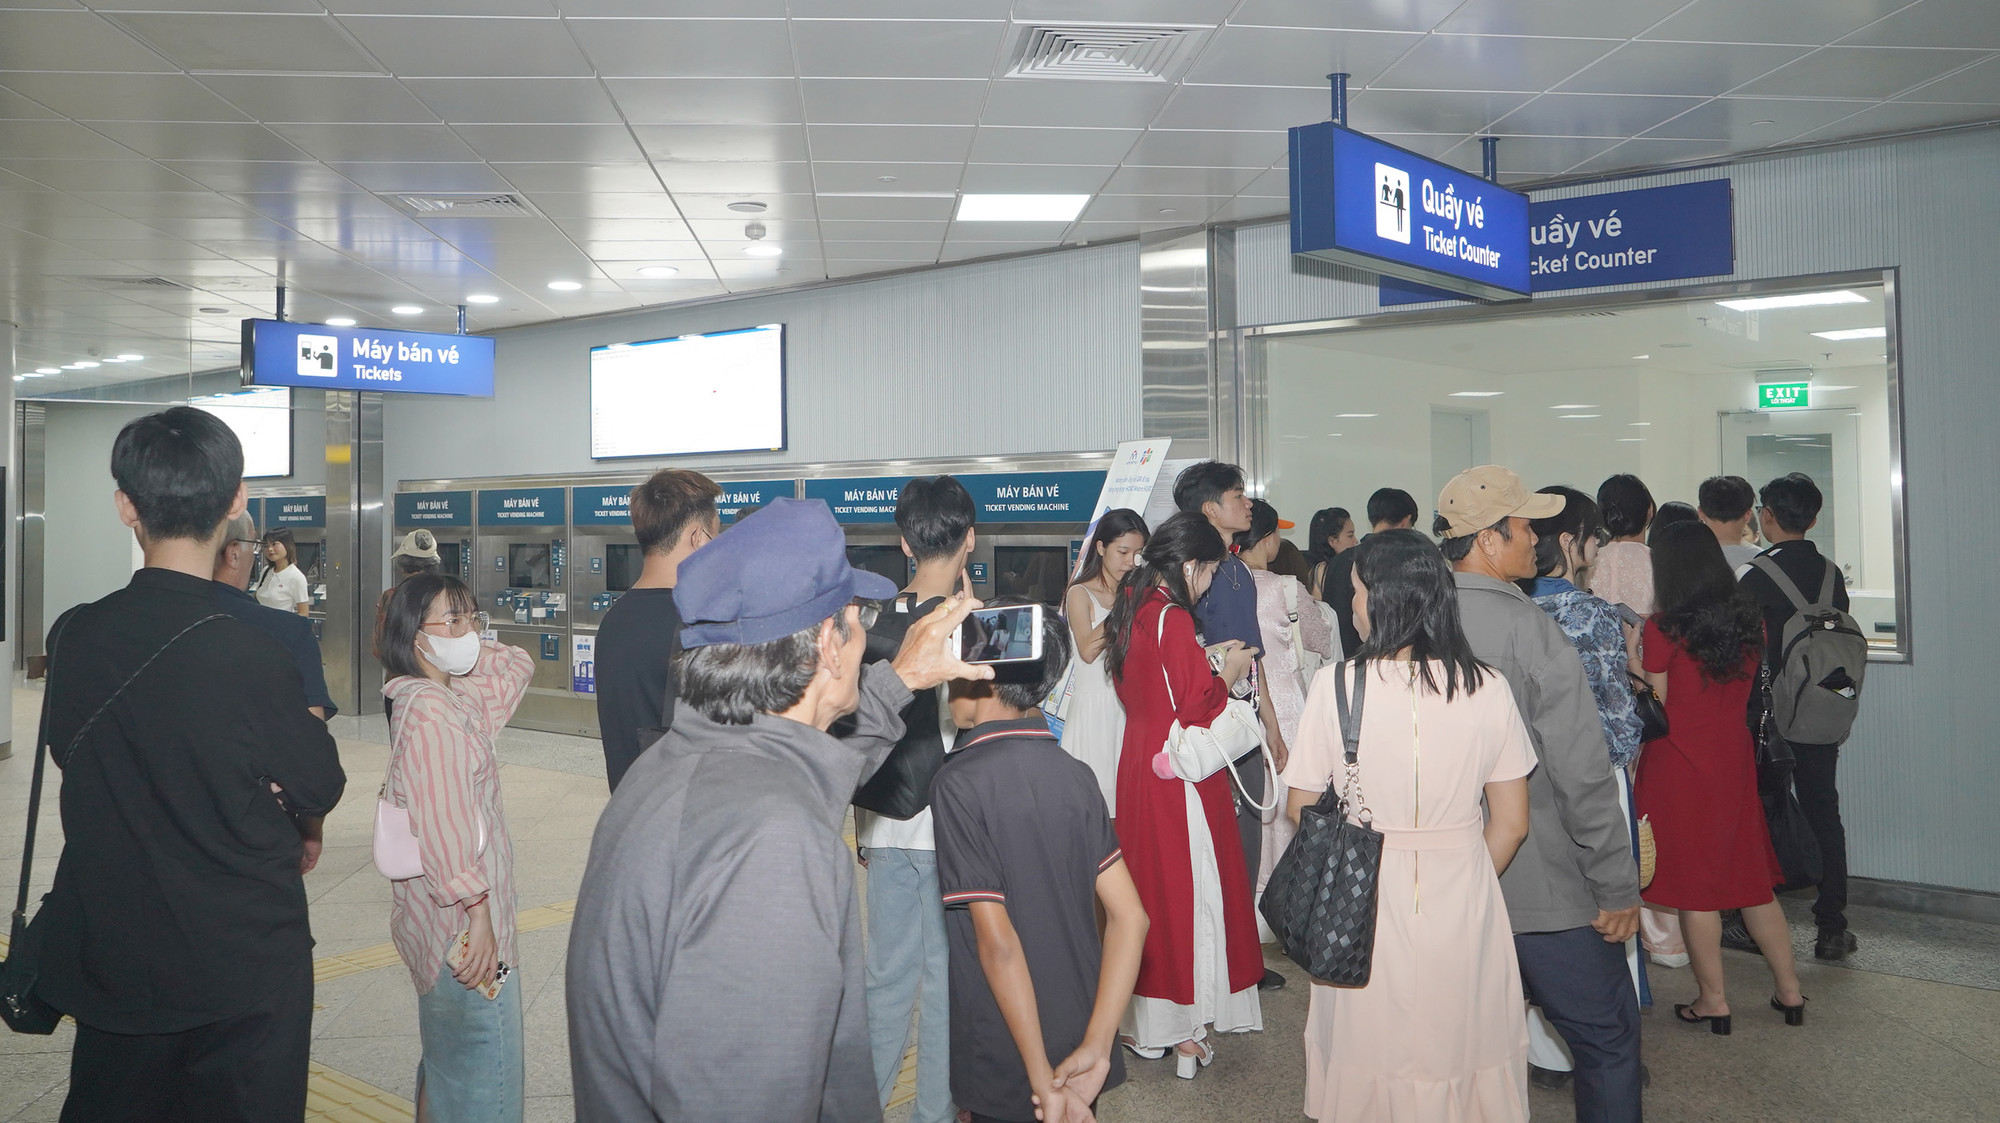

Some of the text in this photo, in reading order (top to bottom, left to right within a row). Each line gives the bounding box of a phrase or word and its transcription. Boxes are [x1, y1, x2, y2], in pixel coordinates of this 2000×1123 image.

[1422, 178, 1485, 230] Quầy vé
[1530, 209, 1622, 249] uầy vé
[1422, 225, 1501, 269] Ticket Counter
[1530, 247, 1658, 275] cket Counter
[352, 337, 460, 365] Máy bán vé
[352, 364, 403, 382] Tickets
[1766, 387, 1801, 398] EXIT
[733, 491, 749, 503] BÁN
[750, 490, 761, 503] VÉ
[844, 487, 898, 502] MÁY BÁN VÉ
[996, 483, 1060, 499] MÁY BÁN VÉ
[416, 499, 449, 510] MÁY BÁN VÉ
[503, 496, 540, 508] MÁY BÁN VÉ
[602, 495, 618, 506] MÁY
[984, 502, 1070, 512] TICKET VENDING MACHINE
[834, 505, 897, 514] TICKET VENDING MACH
